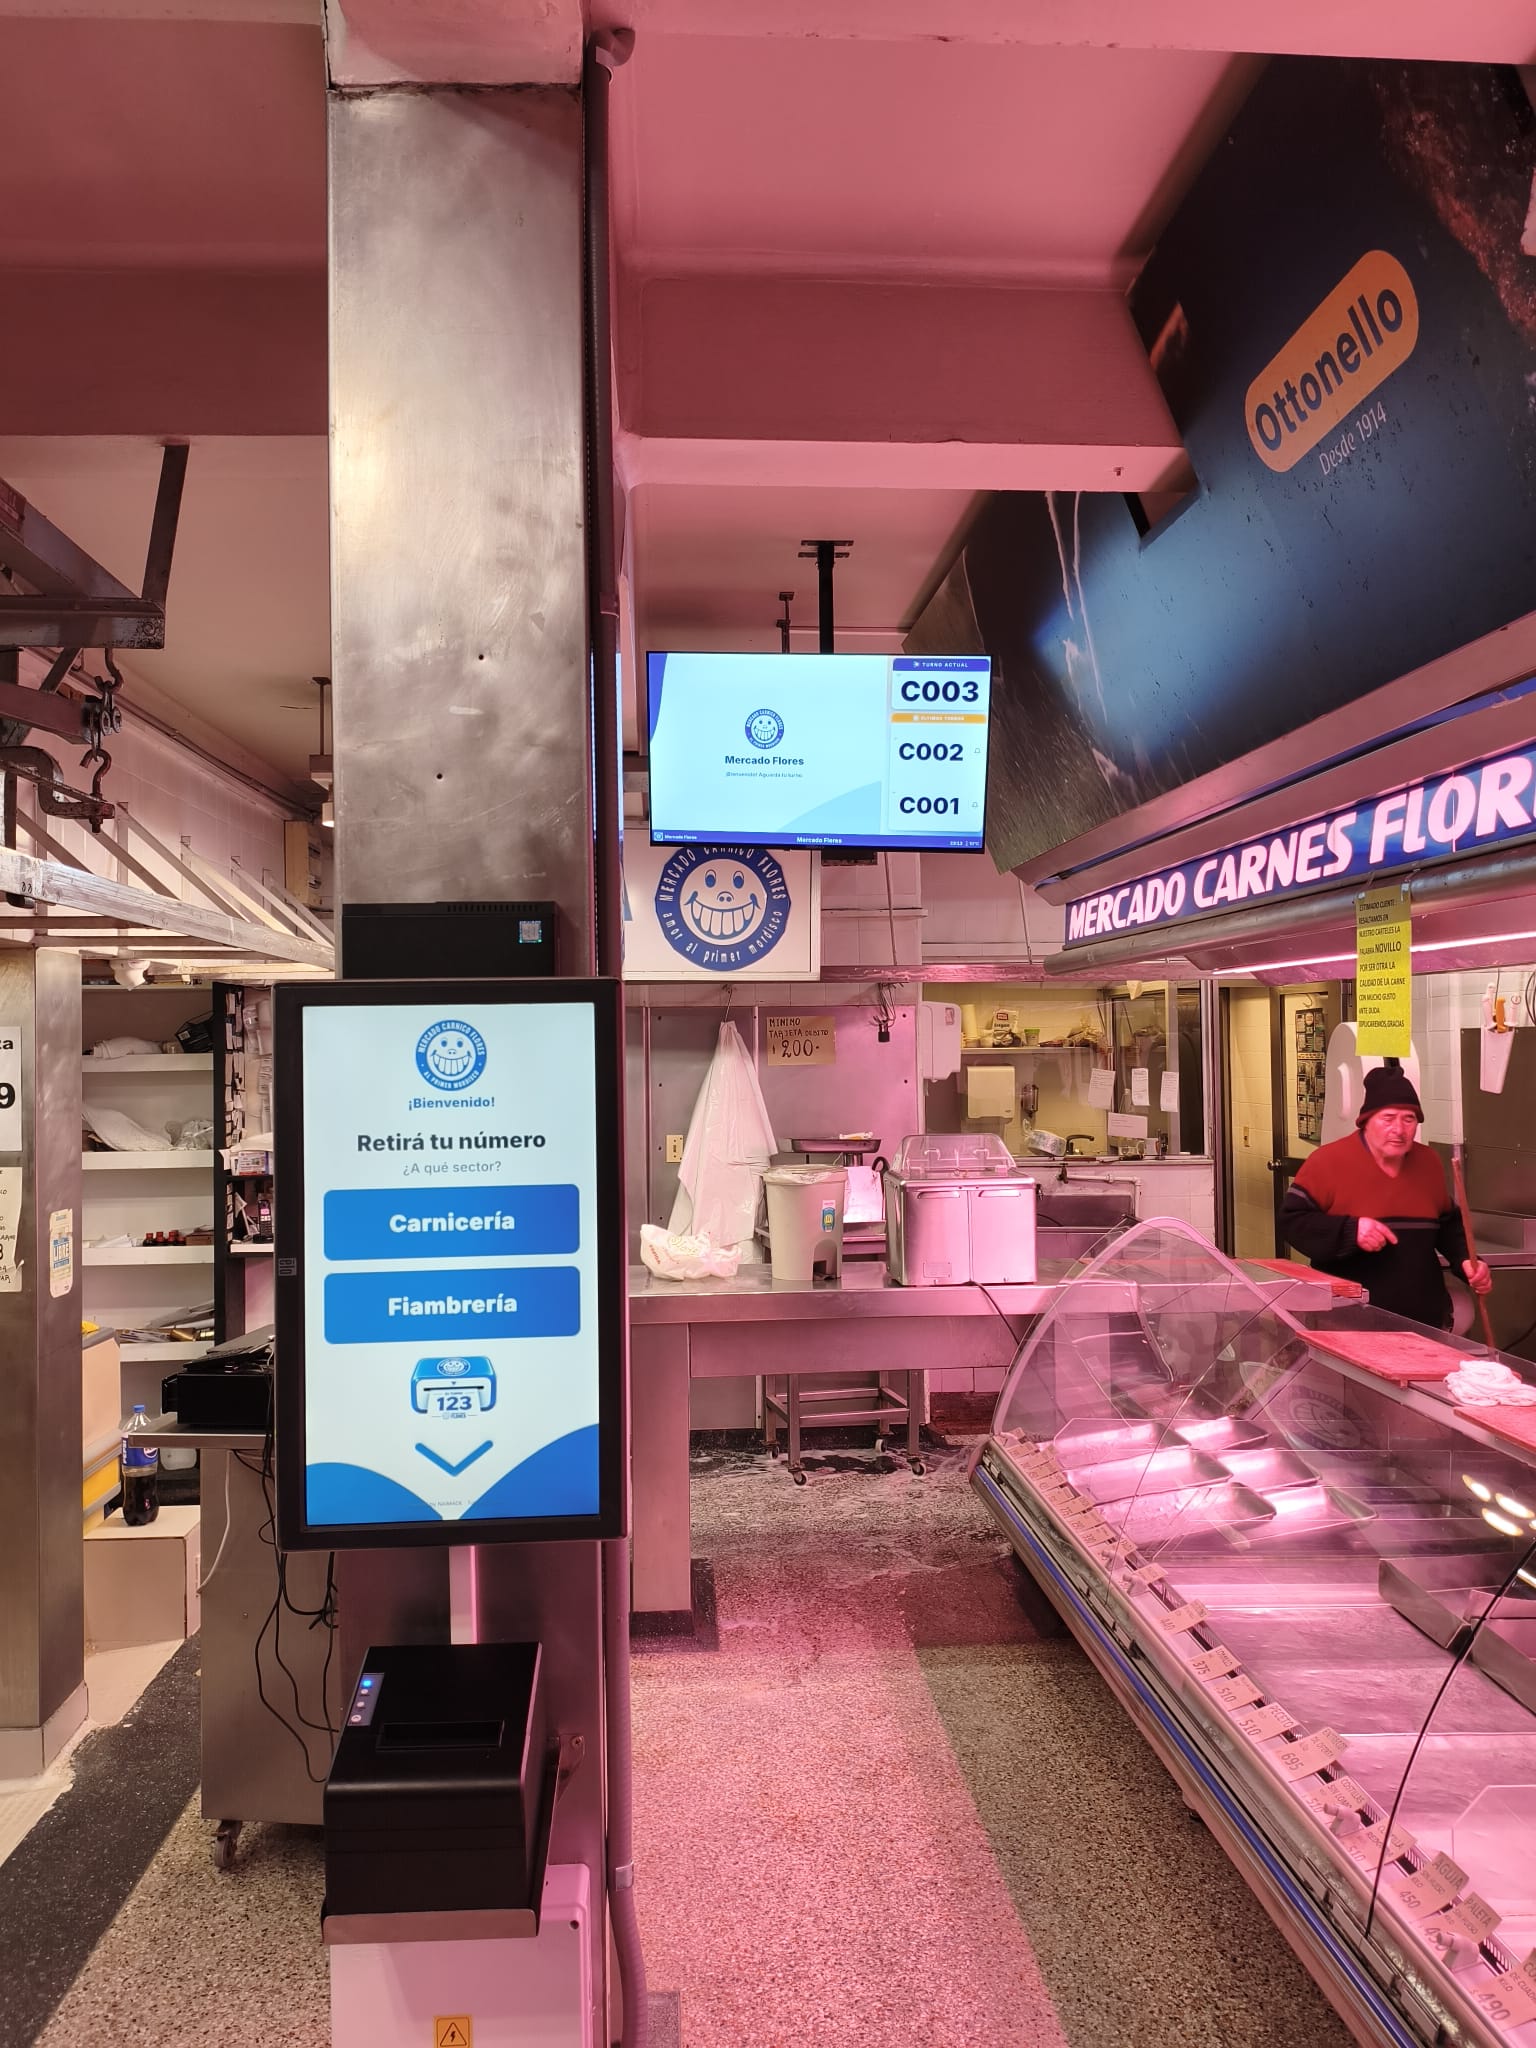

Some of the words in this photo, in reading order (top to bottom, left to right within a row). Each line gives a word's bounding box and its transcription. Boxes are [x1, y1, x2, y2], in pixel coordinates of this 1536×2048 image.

[1255, 289, 1403, 451] Ottonello
[1319, 433, 1356, 475] Desde
[1355, 401, 1387, 442] 1914
[901, 680, 979, 702] C003
[724, 755, 770, 765] Mercado
[772, 756, 805, 766] Flores
[899, 742, 964, 761] C002
[899, 796, 960, 815] C001
[797, 836, 823, 844] Mercado
[1067, 871, 1186, 941] MERCADO
[1193, 811, 1358, 909] CARNES
[1369, 755, 1536, 866] FLOR
[660, 848, 697, 902] MERCADO
[756, 857, 787, 900] FLORES
[662, 912, 684, 941] amor
[703, 949, 741, 963] primer
[748, 911, 783, 954] mordisco
[1394, 925, 1401, 933] LA
[1375, 941, 1402, 953] NOVILLO
[1360, 963, 1368, 972] POR
[1376, 962, 1388, 970] OTRA
[1389, 961, 1396, 969] LA
[1390, 977, 1406, 986] CARNE
[1366, 993, 1381, 1001] MUCHO
[1382, 992, 1397, 1001] GUSTO
[769, 1017, 801, 1028] MINIMO
[417, 1025, 441, 1053] MERCADO
[469, 1031, 486, 1056] FLORES
[769, 1029, 803, 1040] TARJETA
[408, 1096, 495, 1111] ¡Bienvenido!
[356, 1132, 425, 1152] Retirá
[430, 1134, 453, 1150] tu
[458, 1130, 547, 1150] número
[402, 1162, 420, 1176] ¿A
[424, 1161, 449, 1176] qué
[452, 1160, 503, 1174] sector?
[389, 1210, 516, 1233] Carnicería
[388, 1293, 518, 1317] Fiambrería
[436, 1395, 473, 1412] 123
[1192, 1660, 1211, 1675] 375
[1217, 1687, 1238, 1703] 510
[1268, 1705, 1295, 1728] PECETO
[1239, 1719, 1262, 1736] 510
[1281, 1751, 1305, 1772] 695
[1400, 1890, 1421, 1909] 450
[1463, 1897, 1493, 1928] PALETA
[1478, 1993, 1511, 2021] 490
